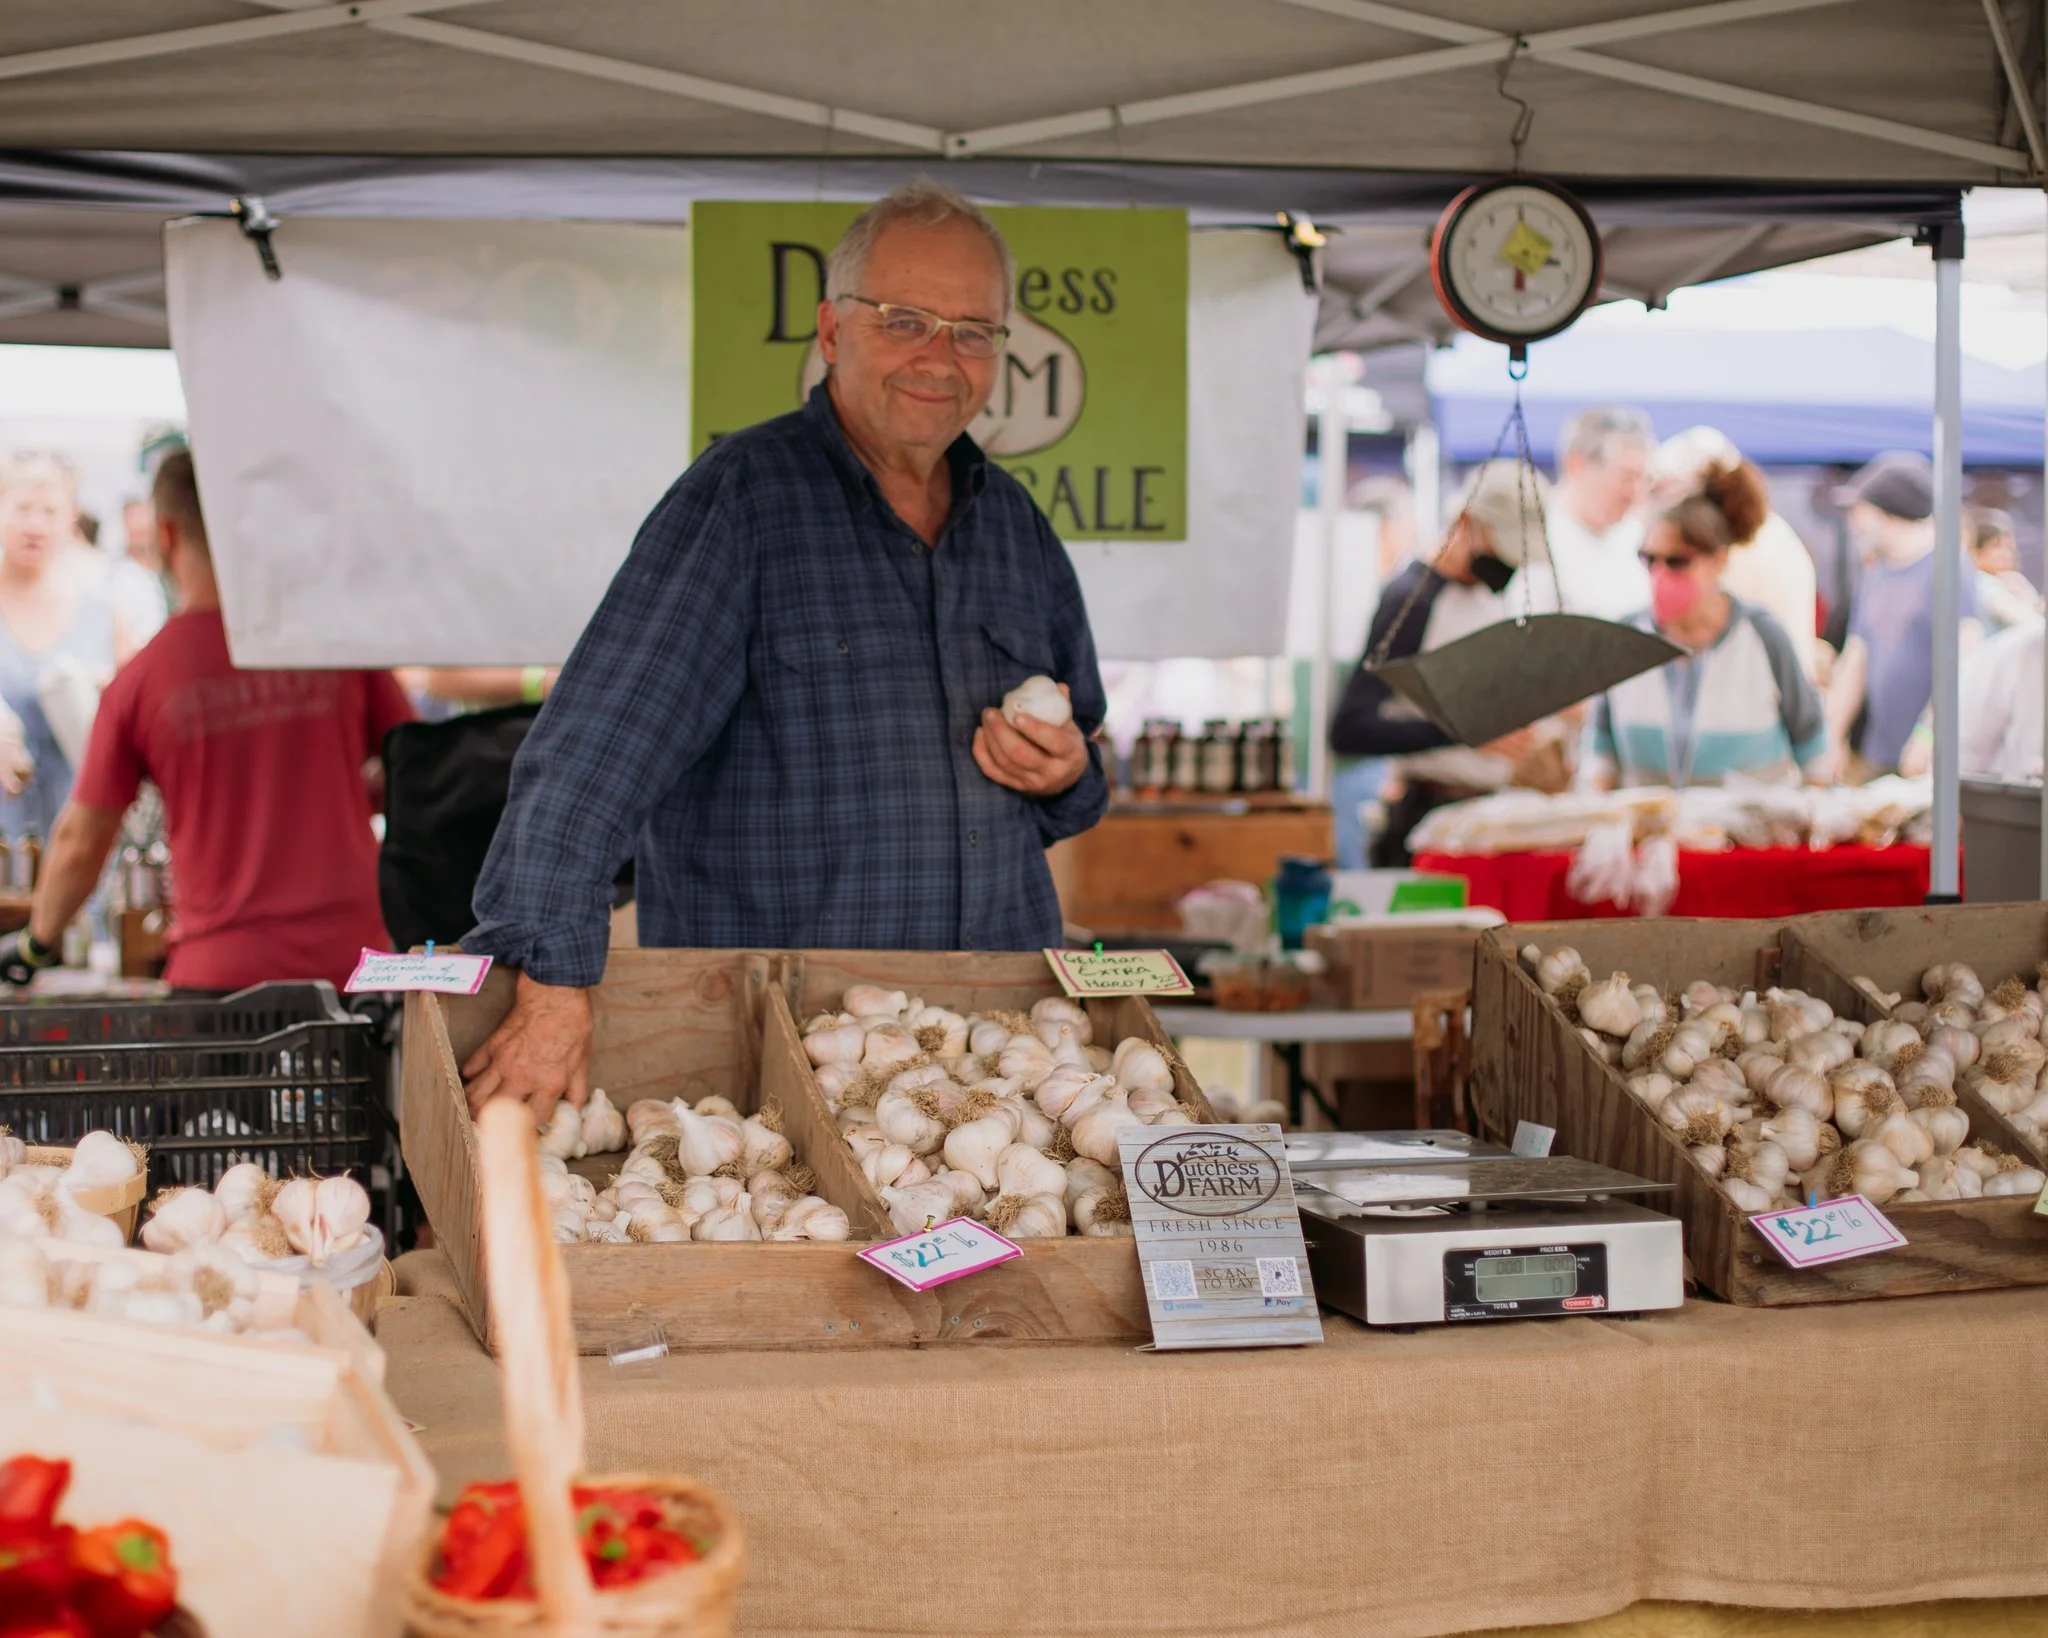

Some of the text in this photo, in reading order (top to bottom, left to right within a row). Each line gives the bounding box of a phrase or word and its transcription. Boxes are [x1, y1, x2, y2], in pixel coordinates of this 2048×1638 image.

[1153, 1159, 1260, 1198] Dutchess
[1186, 1176, 1264, 1197] FARM
[1149, 1217, 1284, 1233] FRESH SINCE
[1199, 1239, 1243, 1253] 1986
[1205, 1267, 1248, 1279] SCAN
[1203, 1278, 1257, 1289] TO PAY
[1493, 1302, 1509, 1310] TOTAL
